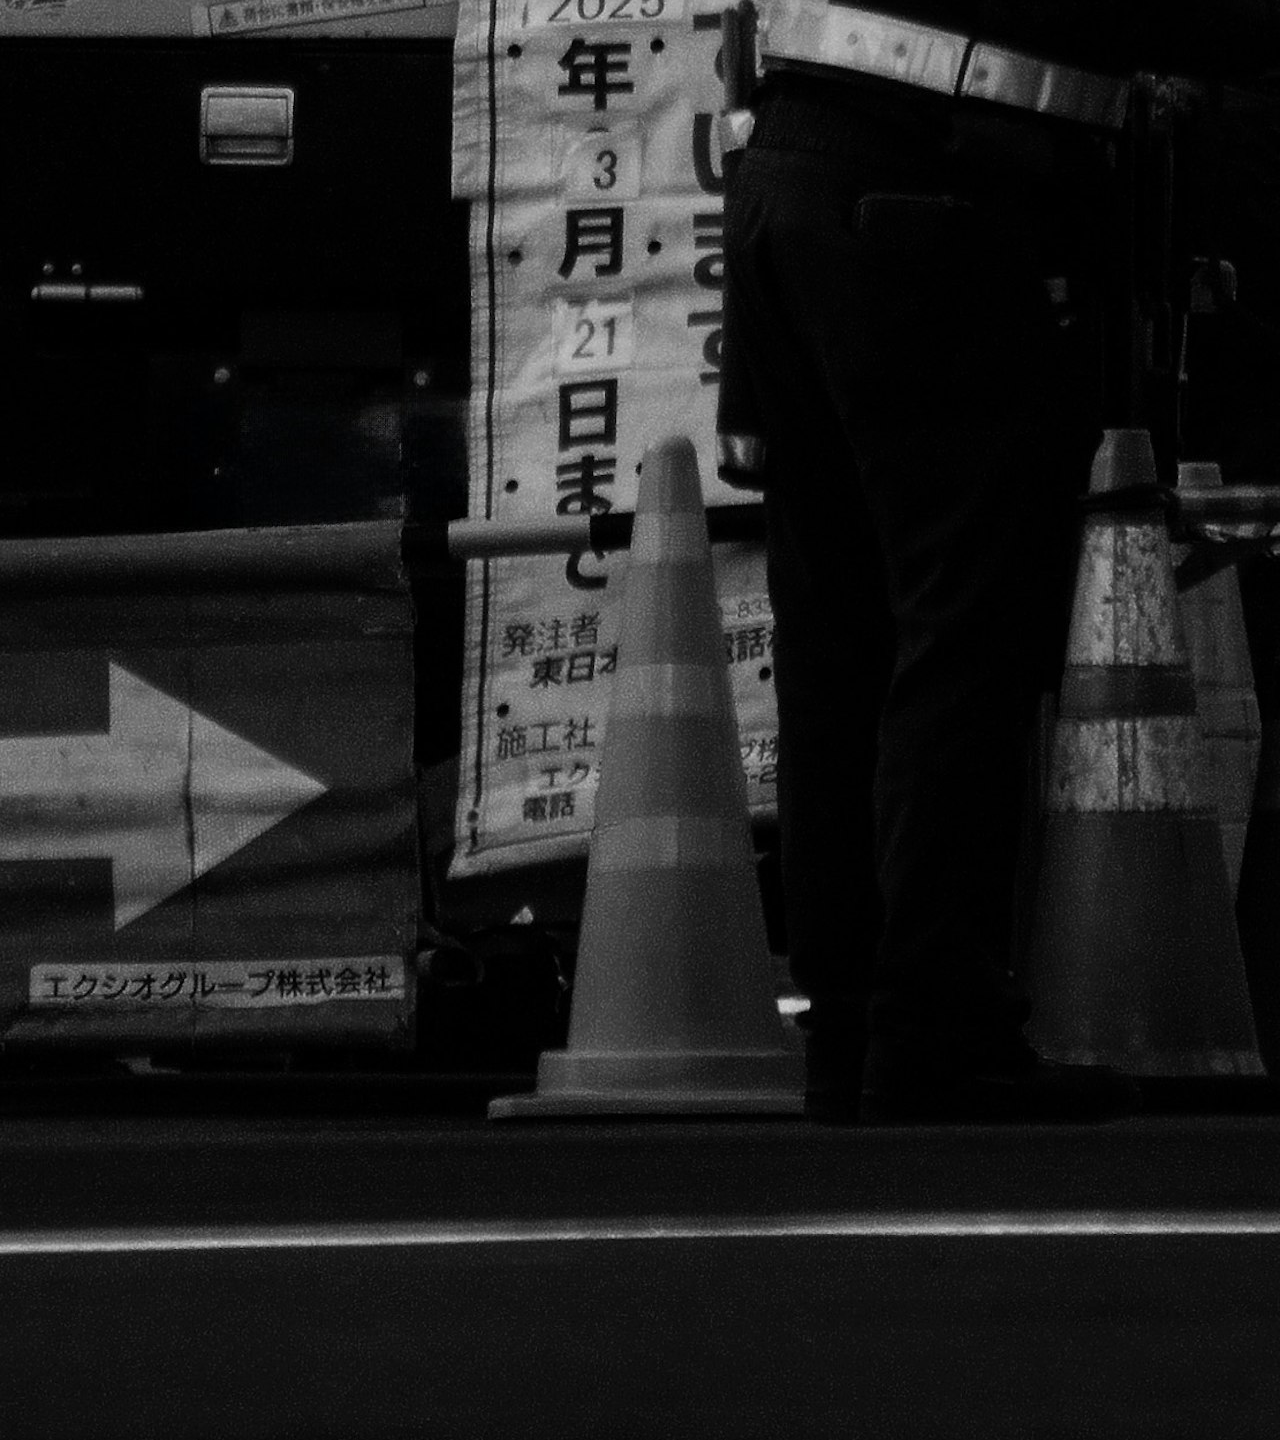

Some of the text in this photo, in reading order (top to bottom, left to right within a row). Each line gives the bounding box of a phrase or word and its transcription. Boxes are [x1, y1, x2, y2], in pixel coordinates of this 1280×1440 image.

[503, 612, 601, 658] 発注者
[497, 717, 595, 760] 施工社
[42, 964, 392, 1001] エクシオグループ株式会社
